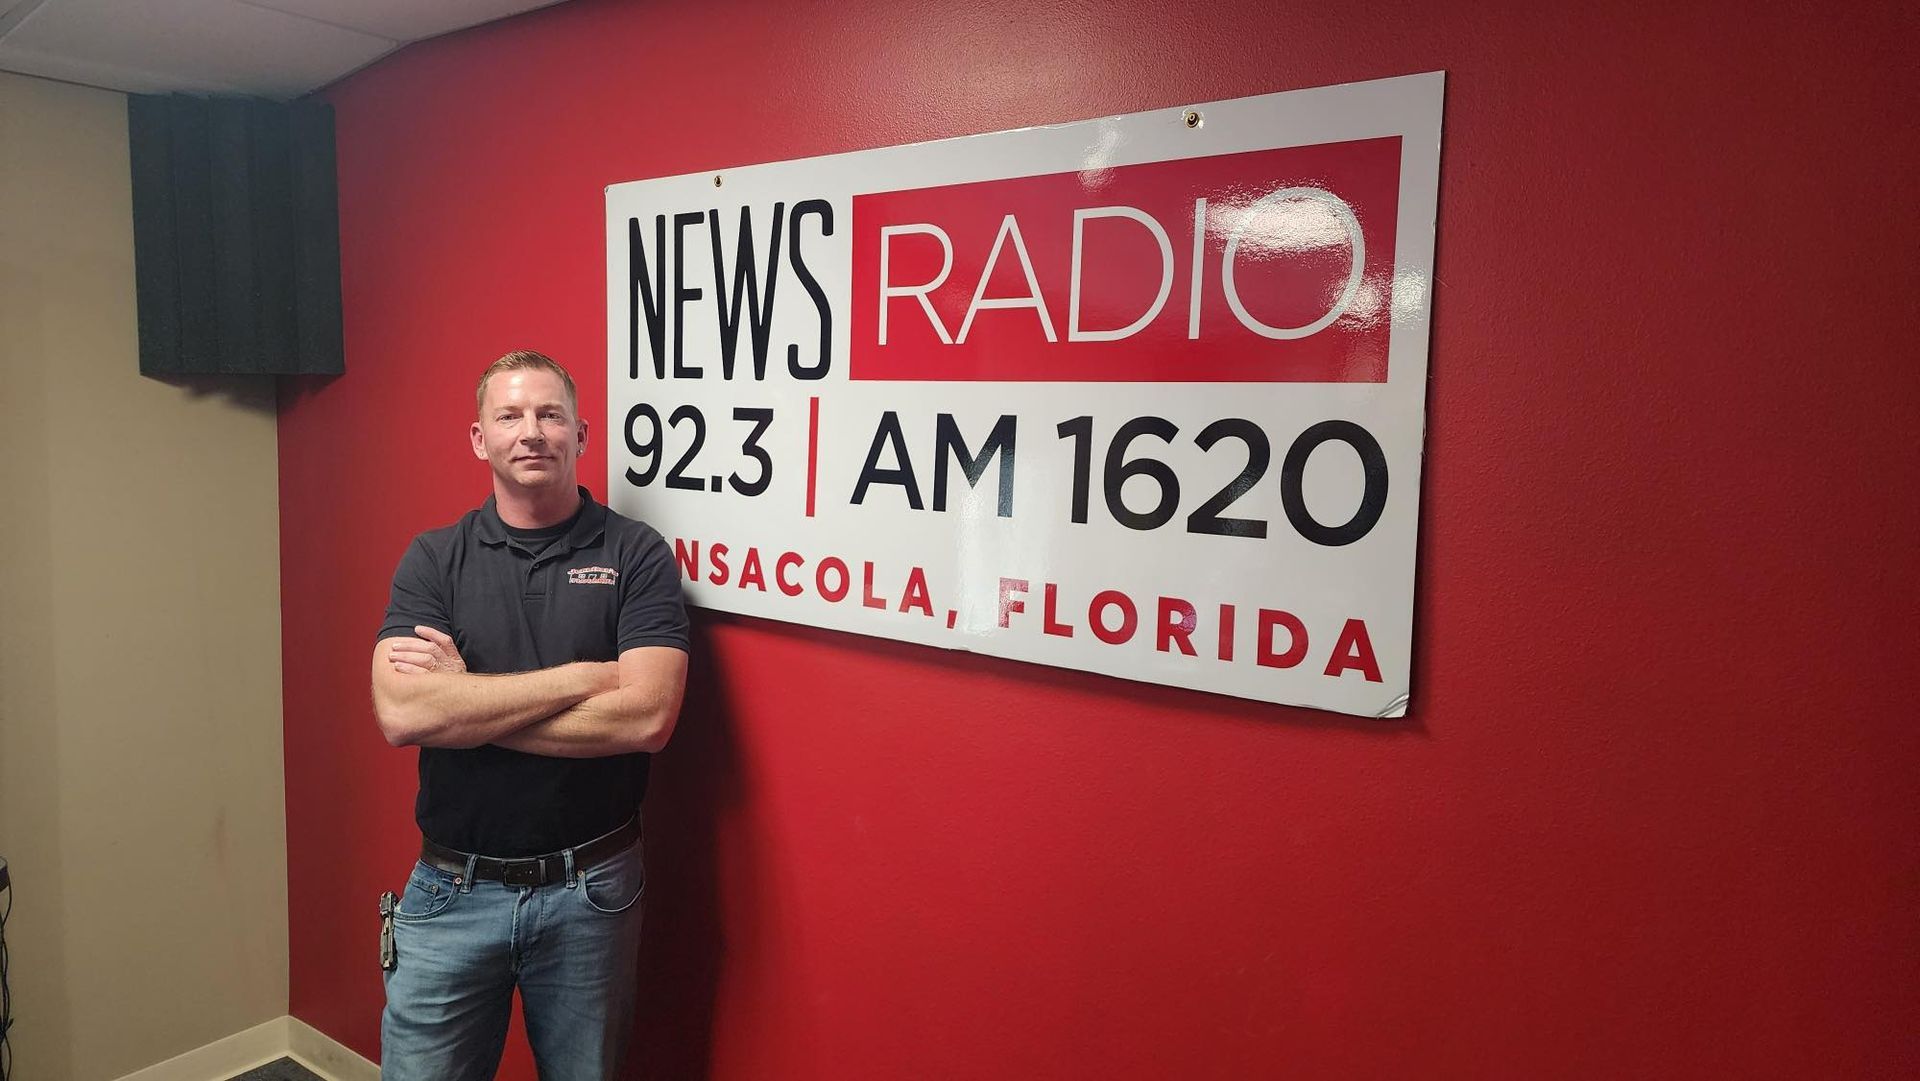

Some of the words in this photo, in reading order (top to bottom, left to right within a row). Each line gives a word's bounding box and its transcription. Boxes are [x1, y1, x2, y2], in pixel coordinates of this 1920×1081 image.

[629, 199, 834, 381] NEWS
[877, 186, 1365, 346] RADIO
[624, 402, 774, 497] 92.3
[850, 411, 1018, 517] AM
[1056, 415, 1389, 546] 1620
[675, 538, 958, 629] NSACOLA,
[997, 576, 1384, 683] FLORIDA
